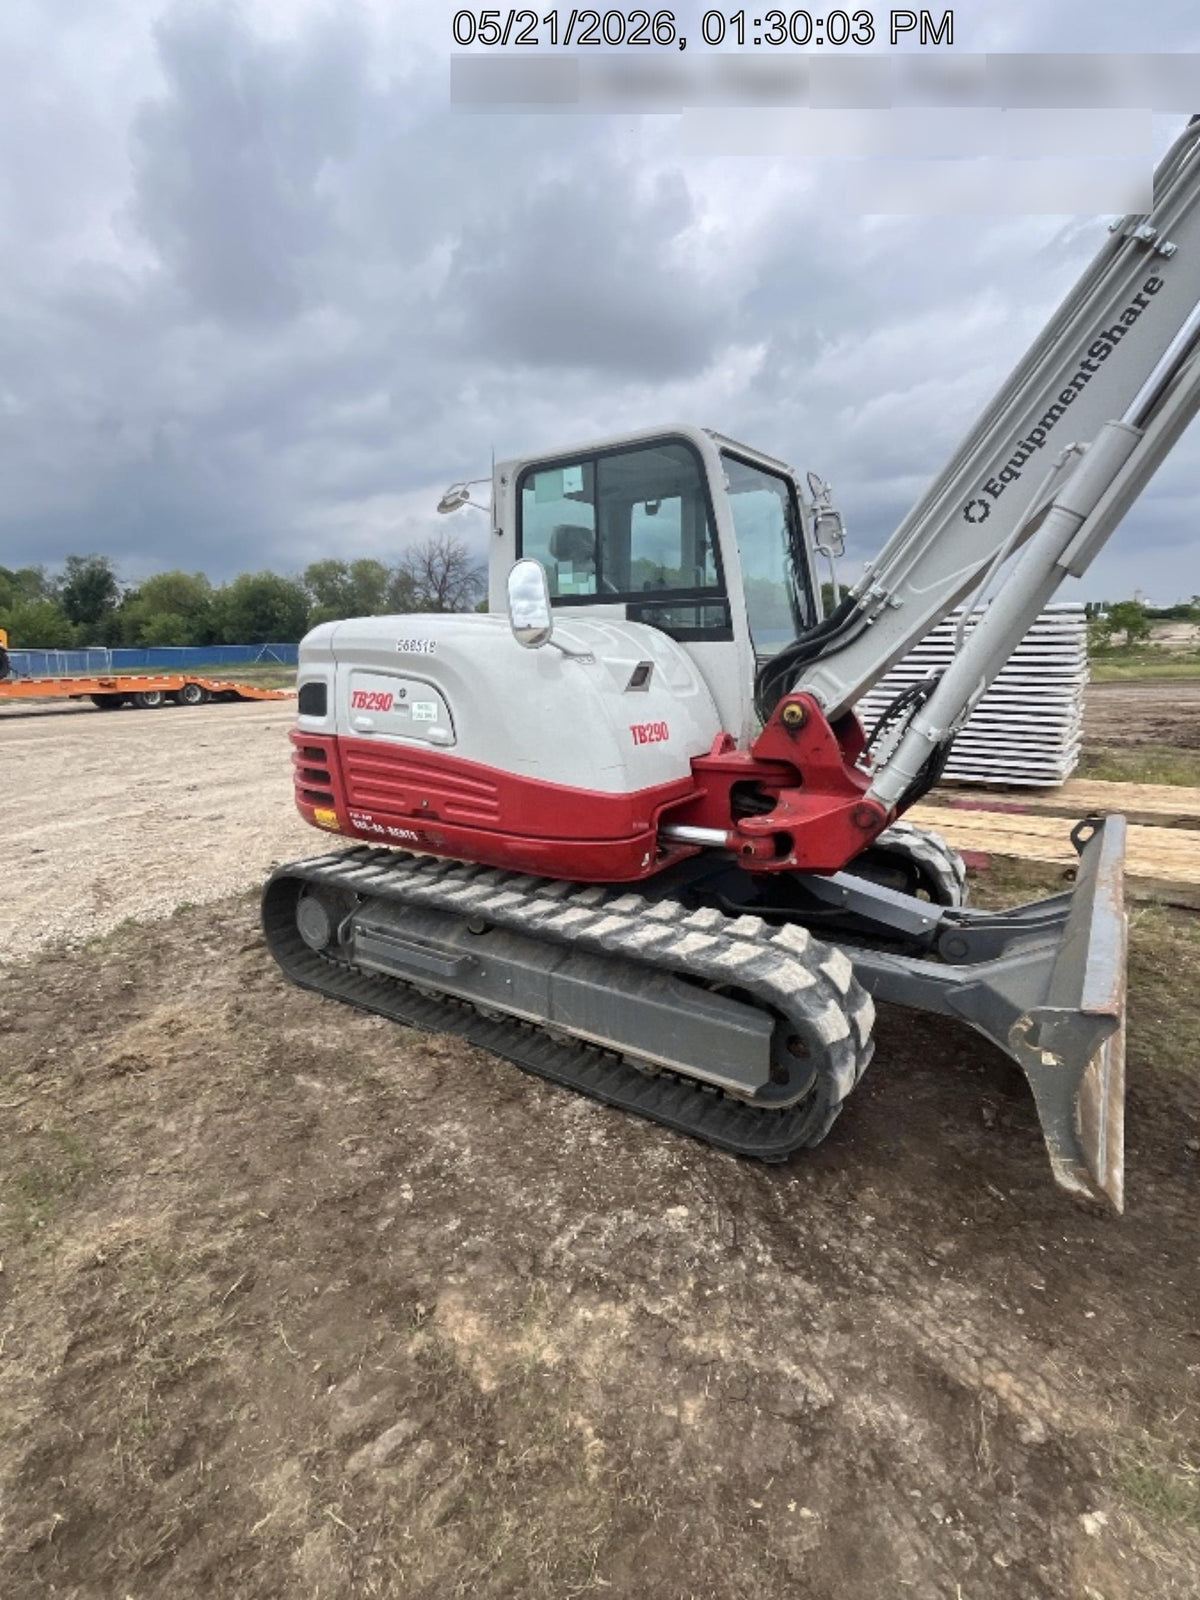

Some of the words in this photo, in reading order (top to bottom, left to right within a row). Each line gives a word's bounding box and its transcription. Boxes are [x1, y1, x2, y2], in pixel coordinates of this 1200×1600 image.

[982, 275, 1165, 500] EquipmentShare
[351, 690, 394, 712] TB290
[629, 721, 670, 746] TB290
